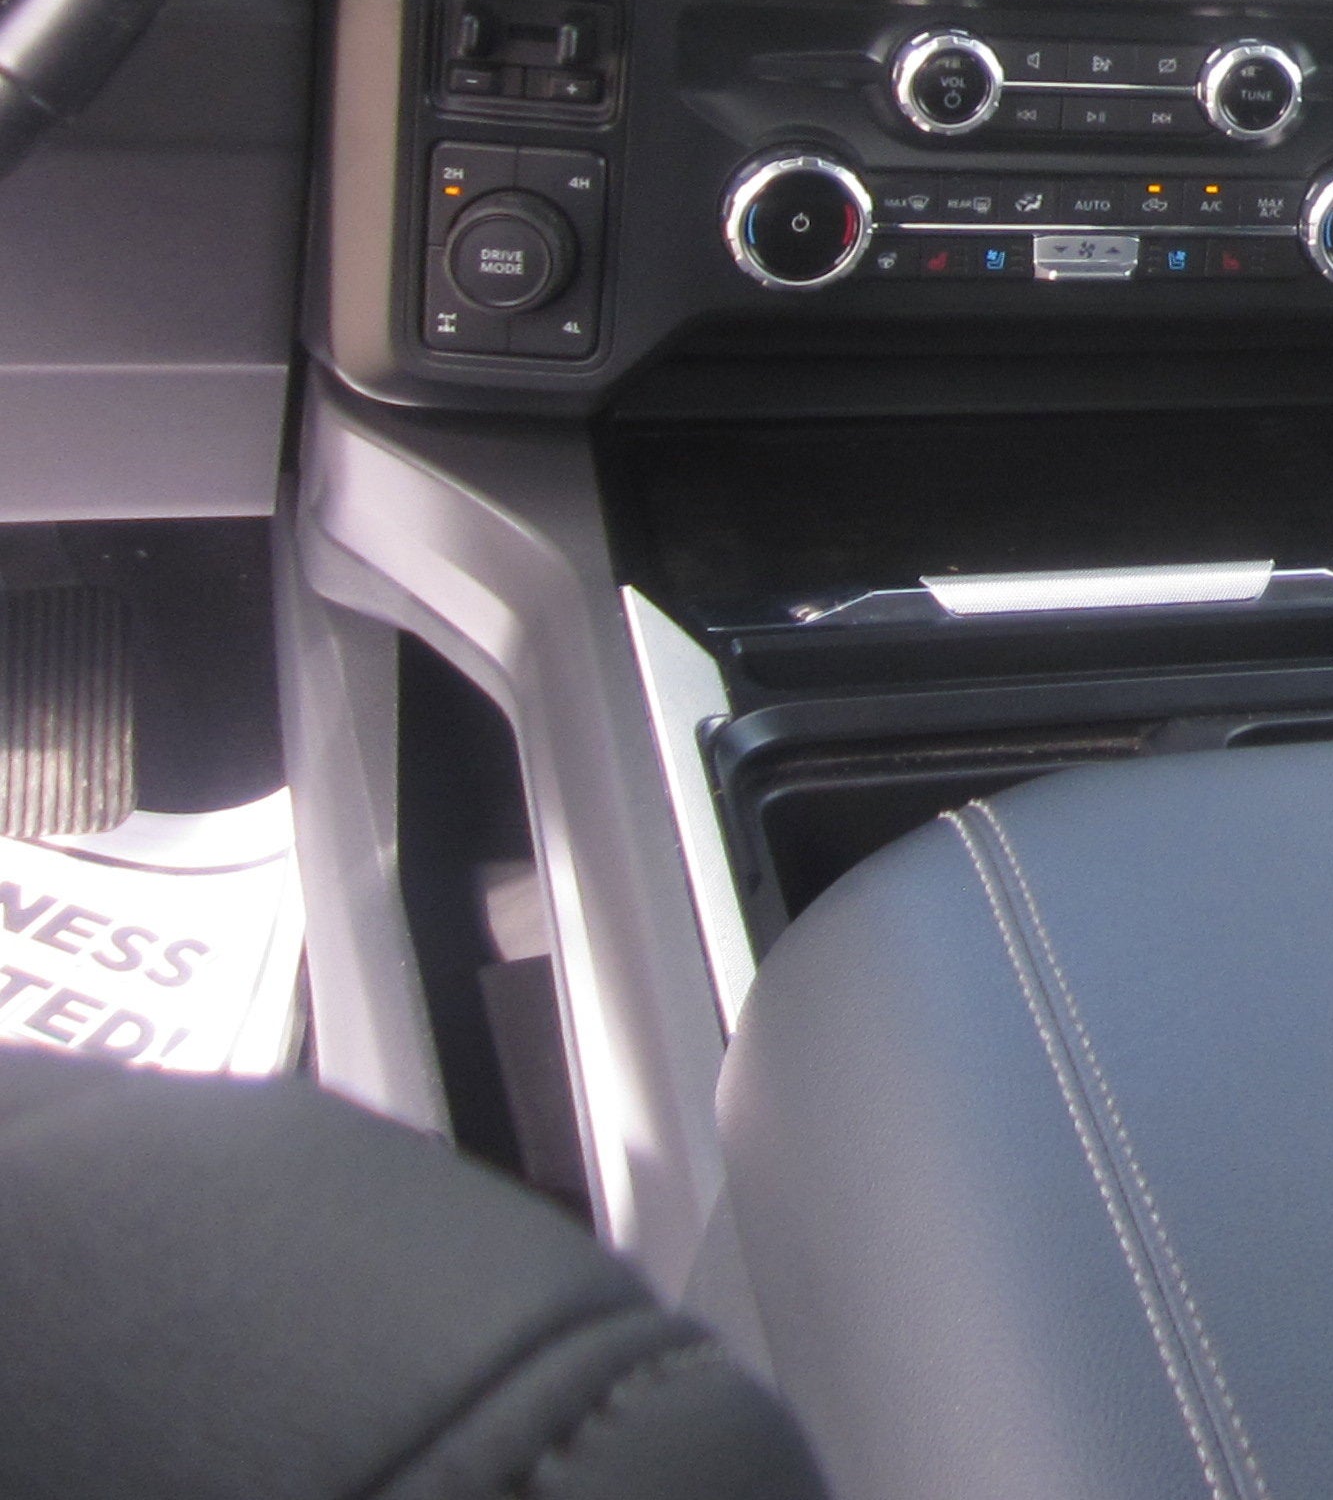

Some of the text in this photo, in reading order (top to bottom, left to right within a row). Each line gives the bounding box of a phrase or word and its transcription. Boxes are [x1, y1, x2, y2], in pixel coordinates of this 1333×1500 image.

[941, 75, 966, 88] VOL
[1241, 89, 1273, 101] TUNE
[443, 167, 464, 180] 2H
[568, 177, 590, 189] 4H
[1074, 200, 1111, 212] AUTO
[1200, 200, 1222, 213] A/C
[1257, 197, 1284, 208] MAX
[1259, 207, 1281, 218] A/C
[480, 248, 524, 262] DRIVE
[480, 261, 524, 275] MODE
[562, 321, 581, 334] 4L
